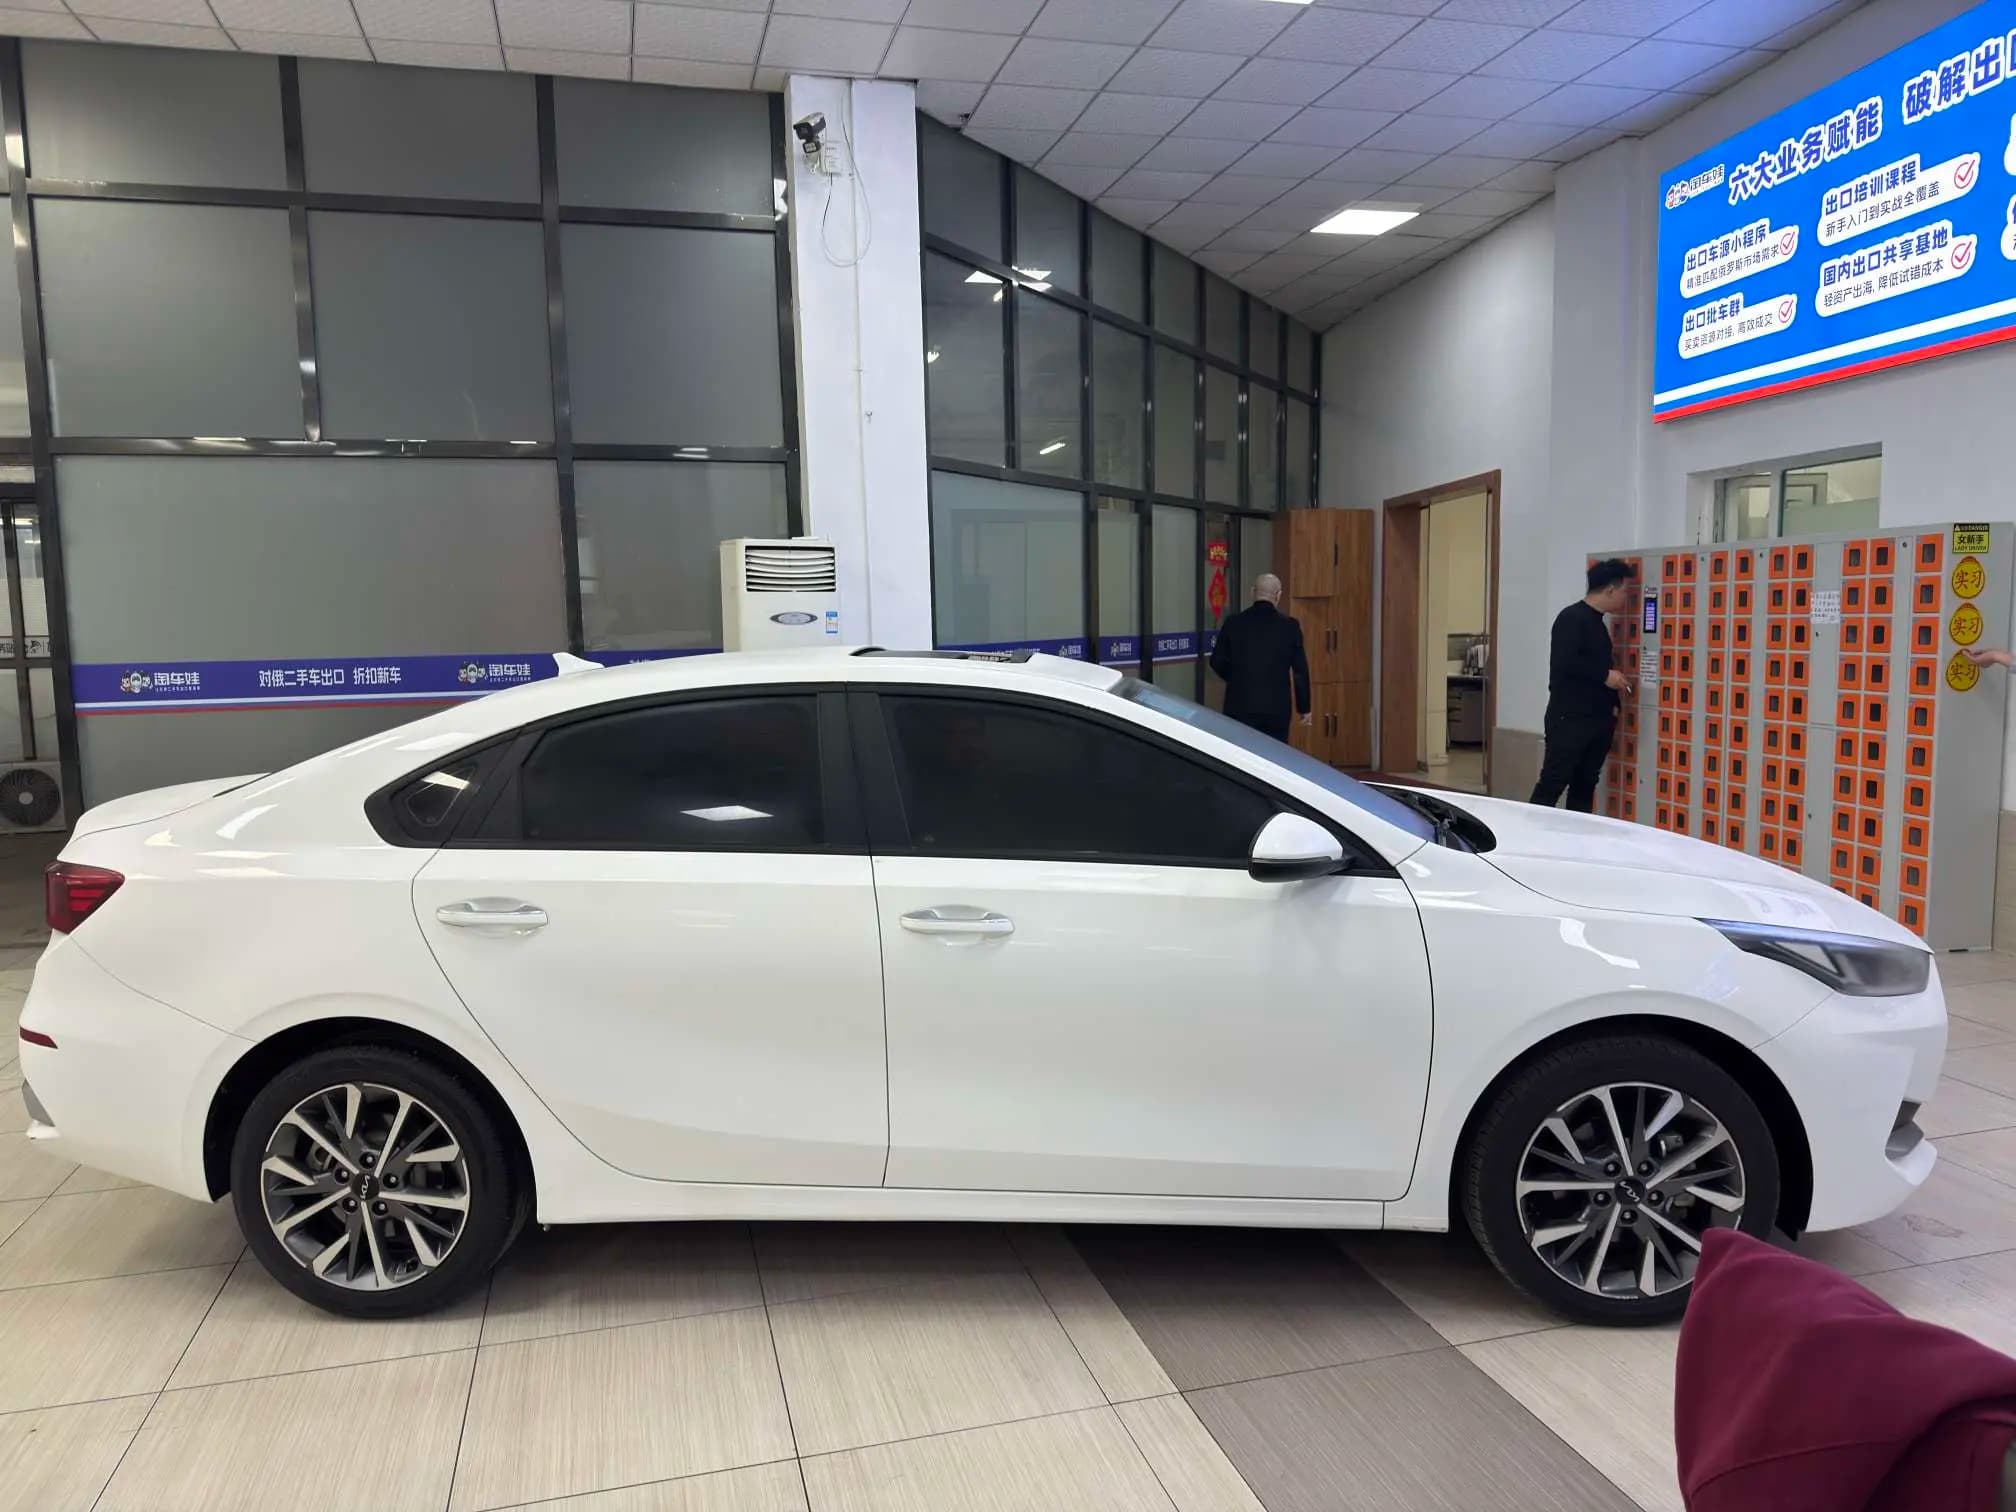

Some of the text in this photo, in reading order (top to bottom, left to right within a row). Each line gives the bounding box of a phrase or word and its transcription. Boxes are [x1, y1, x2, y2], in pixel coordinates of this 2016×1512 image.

[1731, 34, 2016, 201] 六大业务赋能 破解出
[1825, 160, 1917, 216] 出口培训课程
[1825, 181, 1940, 238] 新手入门到实战全覆盖
[1686, 224, 1767, 271] 出口车源小程序
[1823, 226, 1948, 287] 国内出口共享基地
[1686, 245, 1779, 289] 精准匹配俄罗斯市场需求
[1685, 299, 1741, 333] 出口批车群
[1955, 569, 1982, 590] 实习
[1953, 616, 1979, 636] 实习
[154, 671, 200, 686] 淘车娃
[259, 665, 401, 688] 对俄二手车出口 折扣新车
[489, 663, 531, 677] 淘车娃
[1950, 661, 1976, 681] 实习
